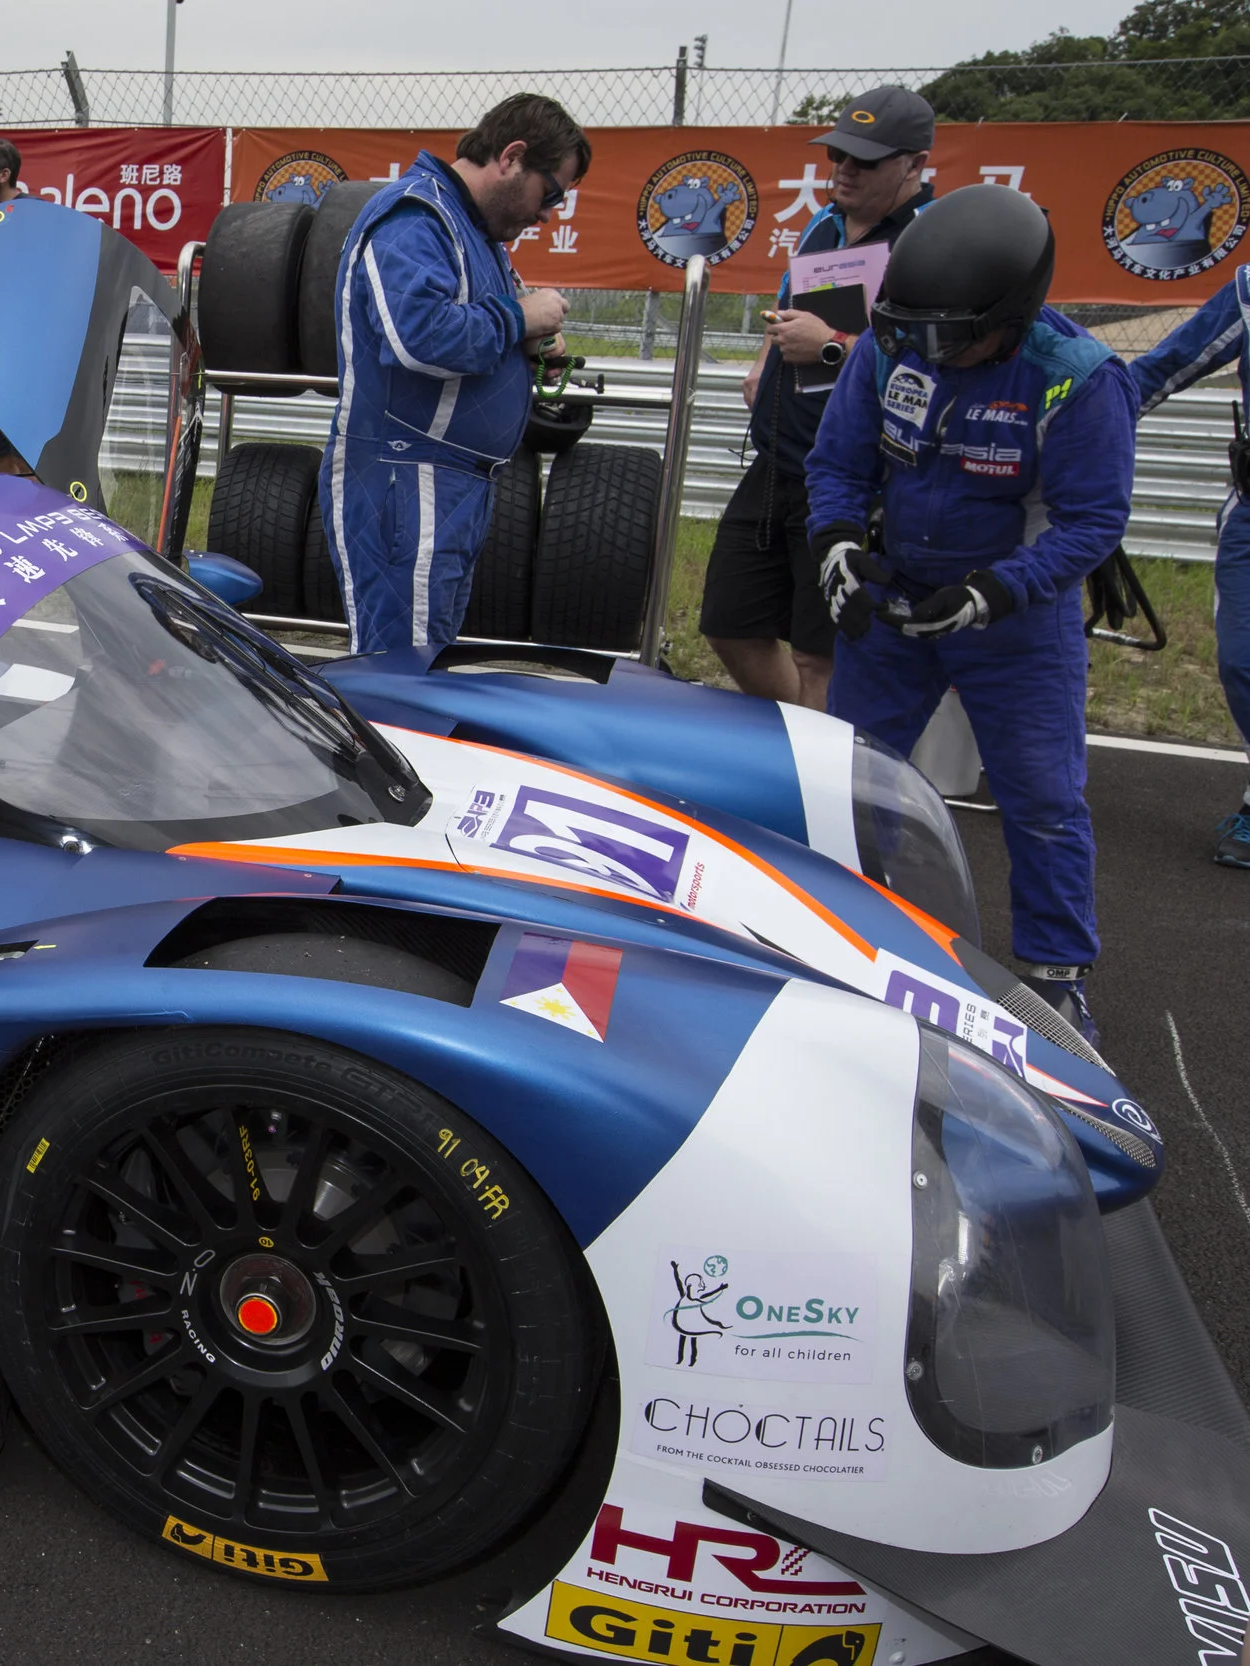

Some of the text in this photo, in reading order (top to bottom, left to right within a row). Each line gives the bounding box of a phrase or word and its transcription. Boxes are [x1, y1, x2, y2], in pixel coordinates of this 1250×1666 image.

[119, 164, 182, 185] 班尼路
[651, 152, 709, 182] AUTOMOTIVE
[710, 152, 747, 177] CULTURE
[1123, 150, 1194, 185] AUTOMOTIVE
[1197, 150, 1240, 178] CULTURE
[885, 399, 916, 415] SERIES
[888, 390, 900, 401] LE
[965, 408, 980, 421] LE
[963, 460, 1015, 475] MOTUL
[1046, 968, 1071, 977] OMP
[437, 1128, 461, 1159] 91
[181, 1308, 217, 1364] RACING
[734, 1344, 852, 1361] for all children
[656, 1444, 865, 1475] FROM THE COCKTAIL OBSESSED CHOCOLATIER
[223, 1543, 314, 1577] Giti
[586, 1566, 867, 1615] HENGRUI CORPORATION
[569, 1604, 758, 1666] Giti
